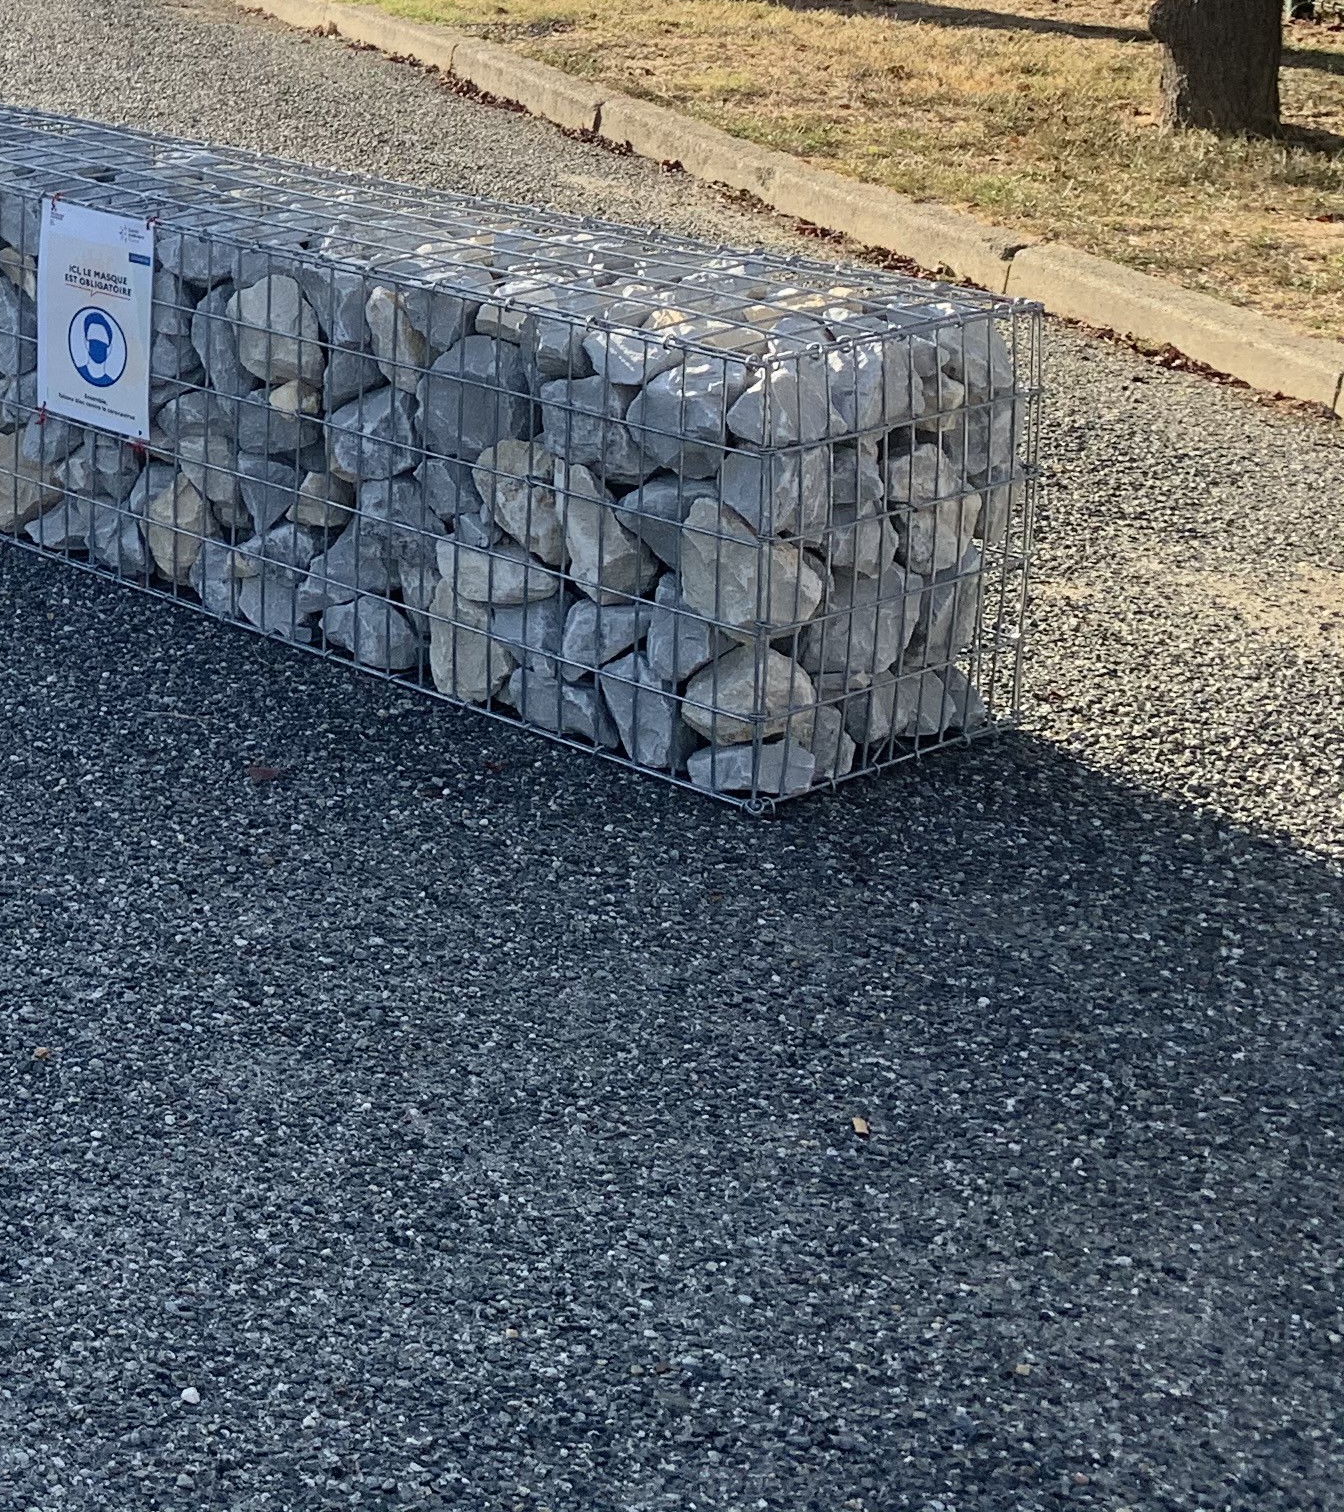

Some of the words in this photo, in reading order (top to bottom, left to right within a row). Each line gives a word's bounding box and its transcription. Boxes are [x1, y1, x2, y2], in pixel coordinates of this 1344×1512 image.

[65, 273, 77, 283] EST
[79, 277, 132, 296] OBLIGATOIRE
[83, 268, 91, 277] LE
[94, 270, 128, 285] MASQUE
